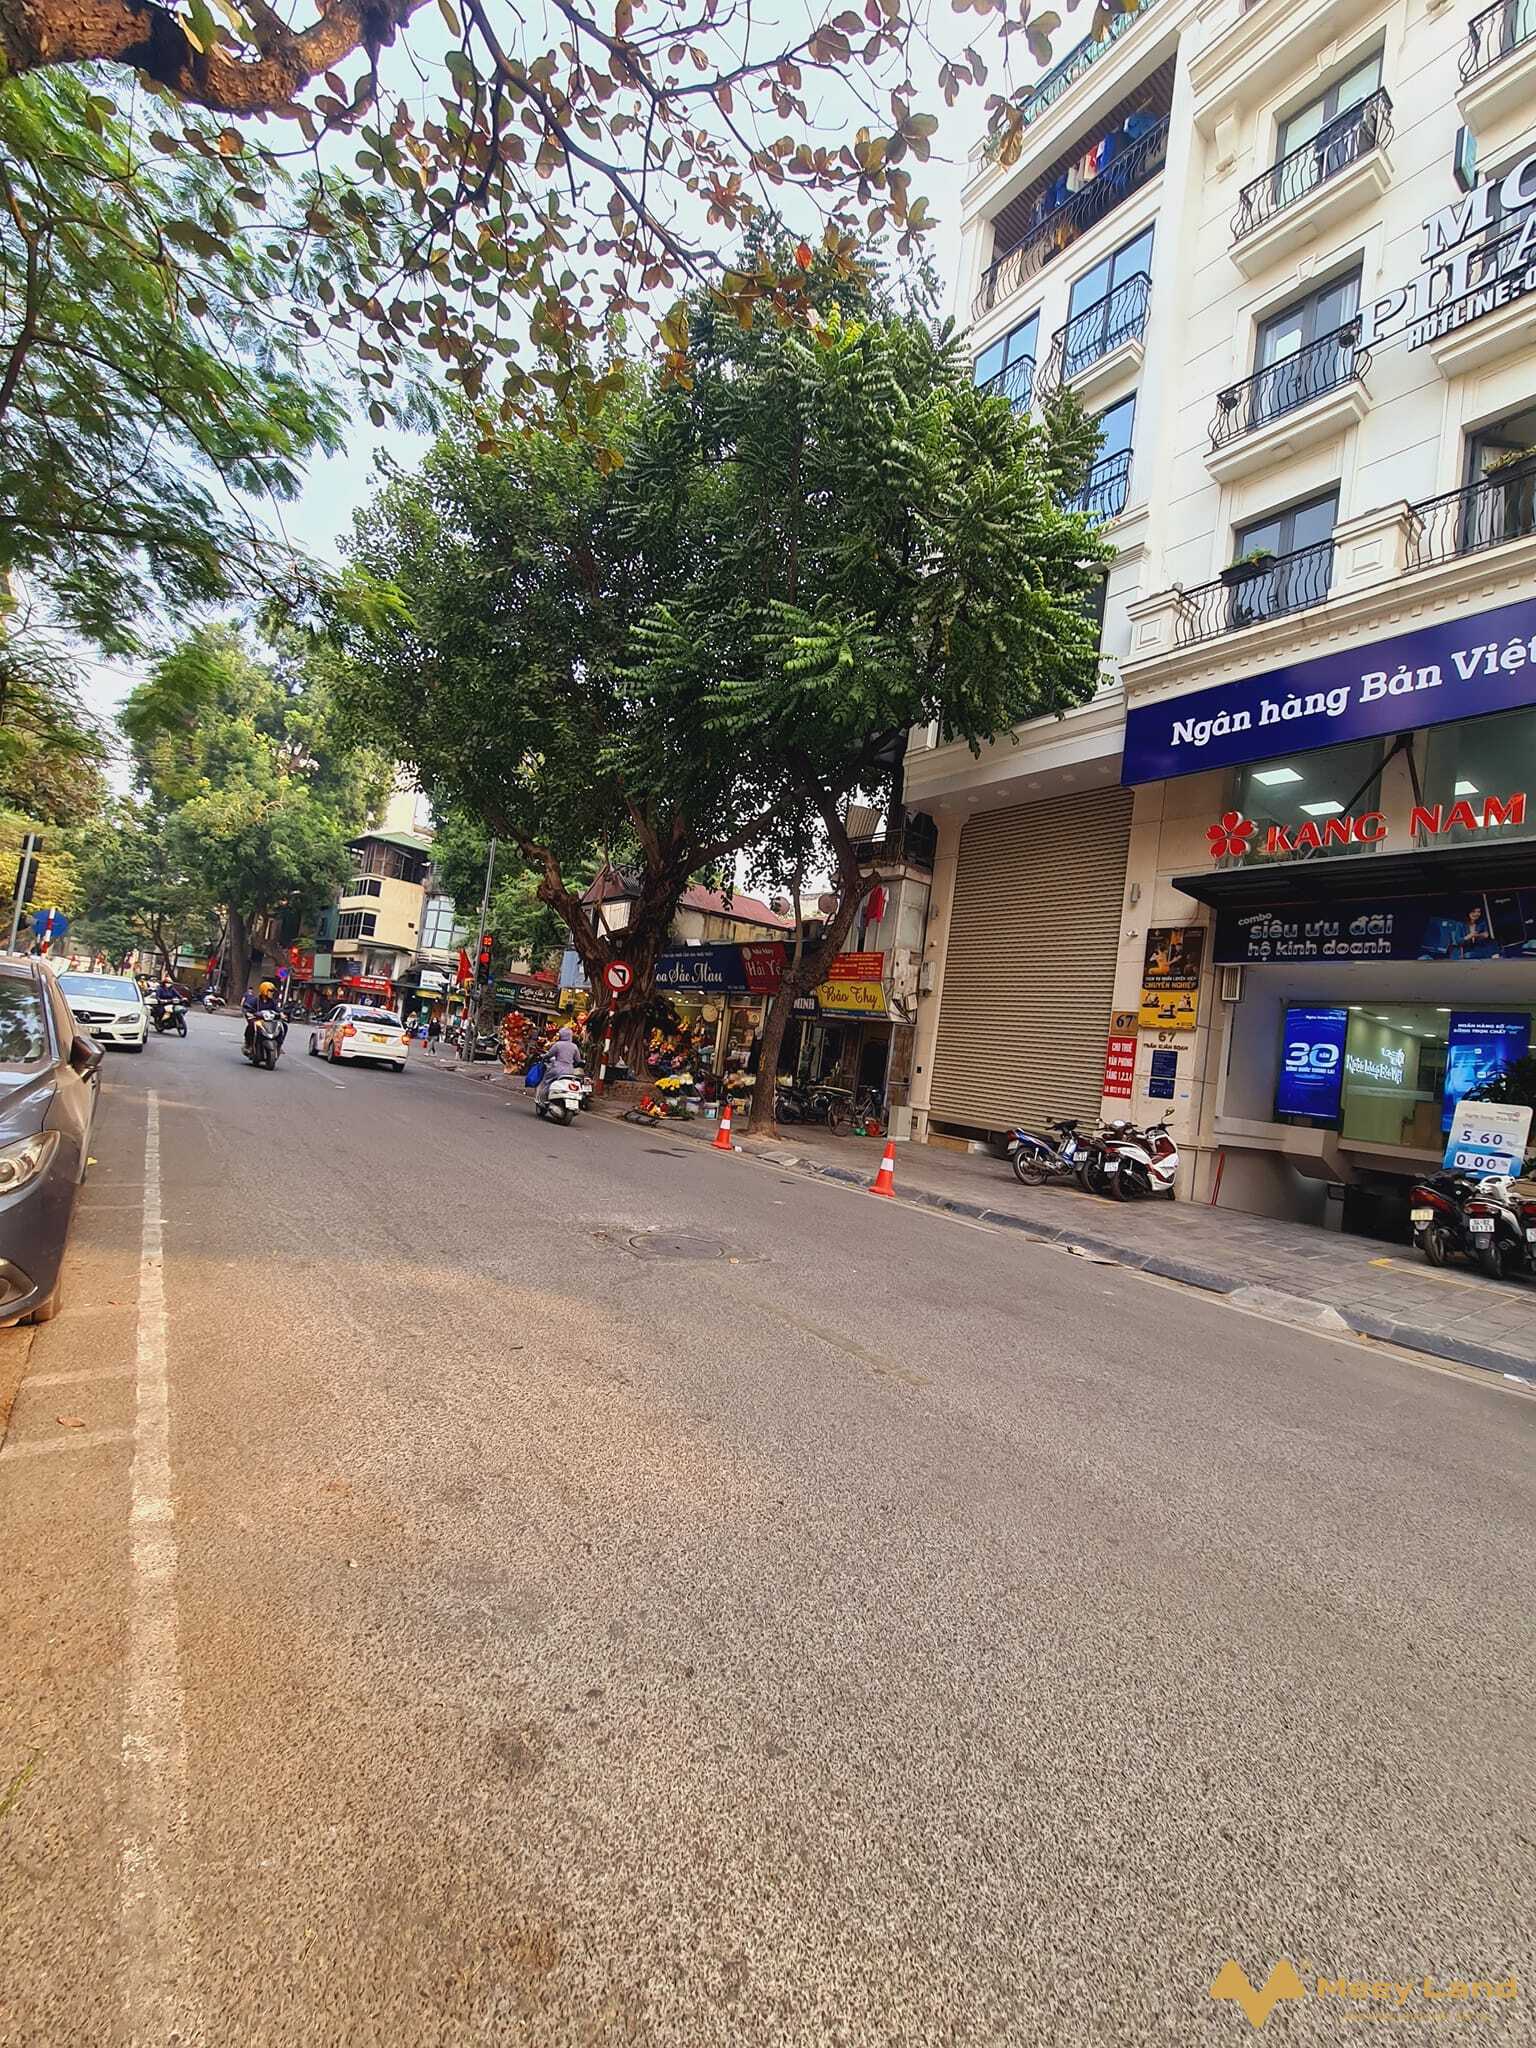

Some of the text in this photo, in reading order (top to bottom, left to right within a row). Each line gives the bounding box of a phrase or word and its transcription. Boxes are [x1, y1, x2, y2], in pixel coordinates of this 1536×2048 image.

[1171, 710, 1252, 747] Ngân
[1258, 686, 1352, 727] hàng
[1359, 662, 1442, 704] Bản
[1266, 791, 1528, 854] KANG NAM
[1238, 912, 1272, 926] combo
[1249, 914, 1394, 939] siêu ưu đãi
[1248, 938, 1392, 961] hộ kinh doanh
[1116, 1015, 1134, 1028] 67
[1159, 1032, 1176, 1043] 67
[1111, 1043, 1121, 1052] CHO
[1286, 1042, 1339, 1067] 30
[1462, 1130, 1503, 1145] 5.60
[1456, 1154, 1497, 1170] 0.00
